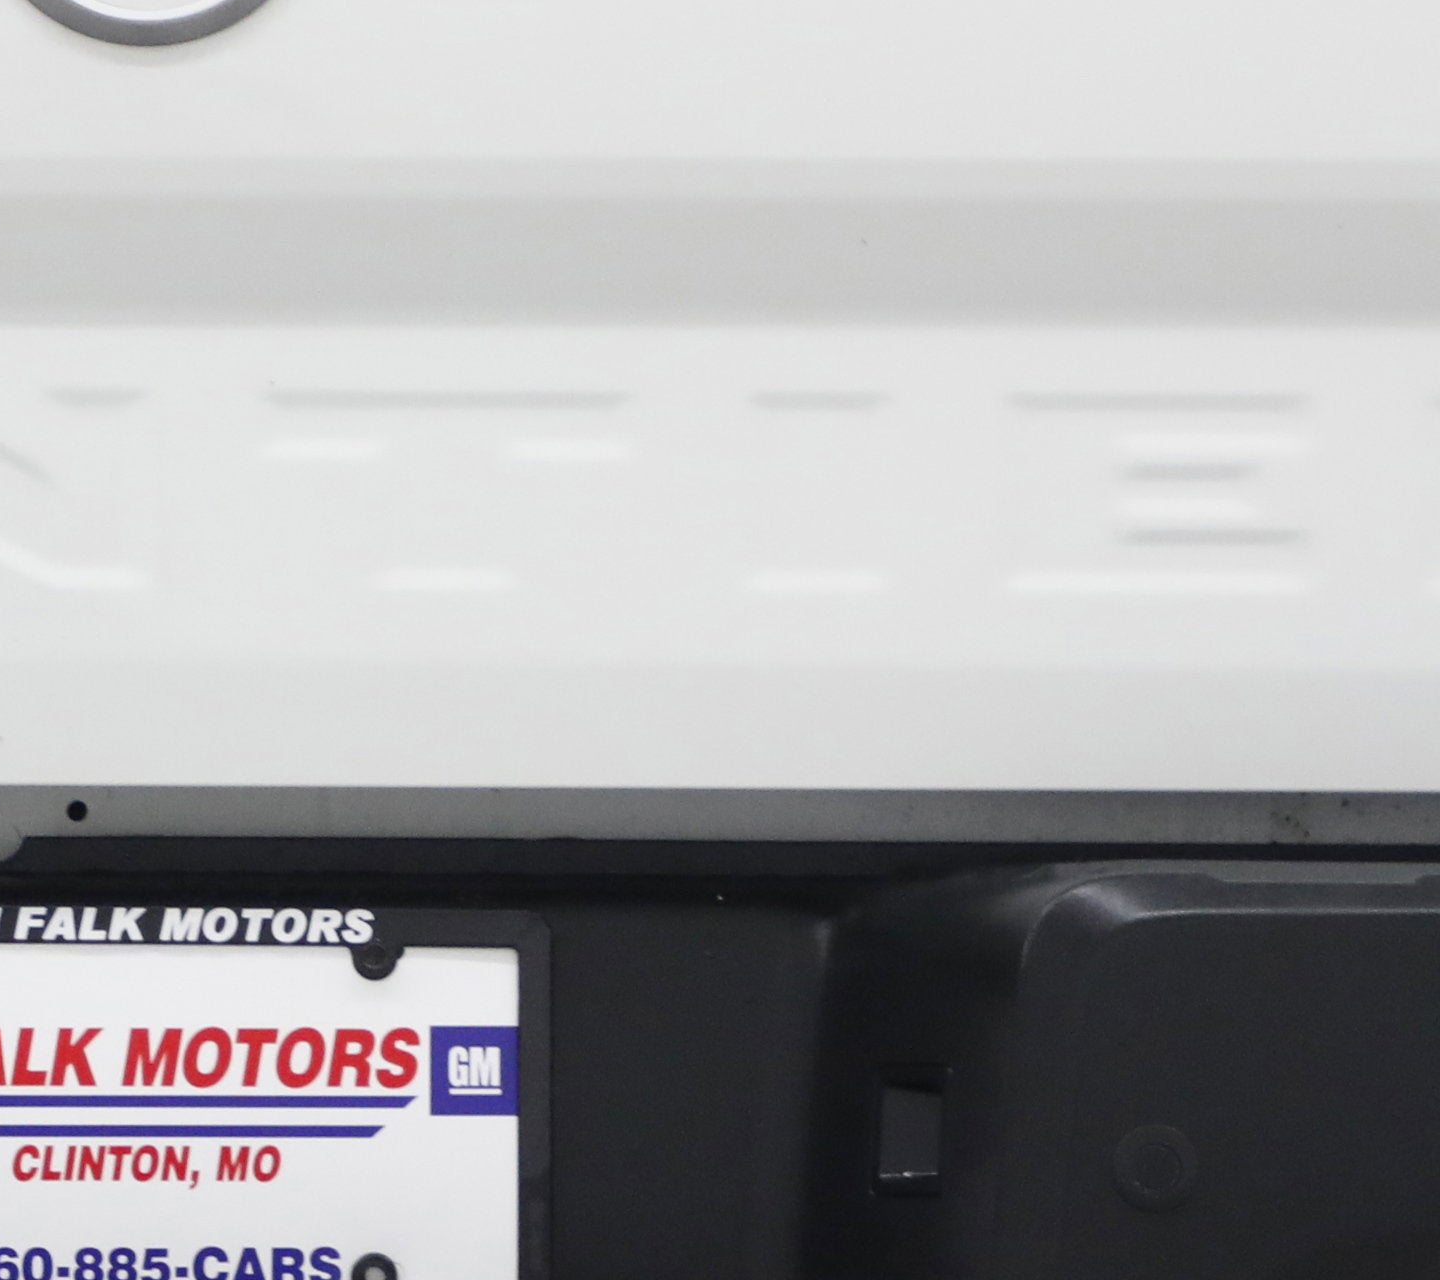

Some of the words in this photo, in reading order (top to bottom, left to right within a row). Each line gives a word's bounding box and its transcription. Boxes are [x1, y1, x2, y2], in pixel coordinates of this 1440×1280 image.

[12, 907, 147, 942] FALK
[159, 908, 376, 944] MOTORS
[121, 1027, 422, 1089] MOTORS
[446, 1045, 502, 1089] GM
[11, 1144, 201, 1189] CLINTON,
[215, 1145, 282, 1183] MO
